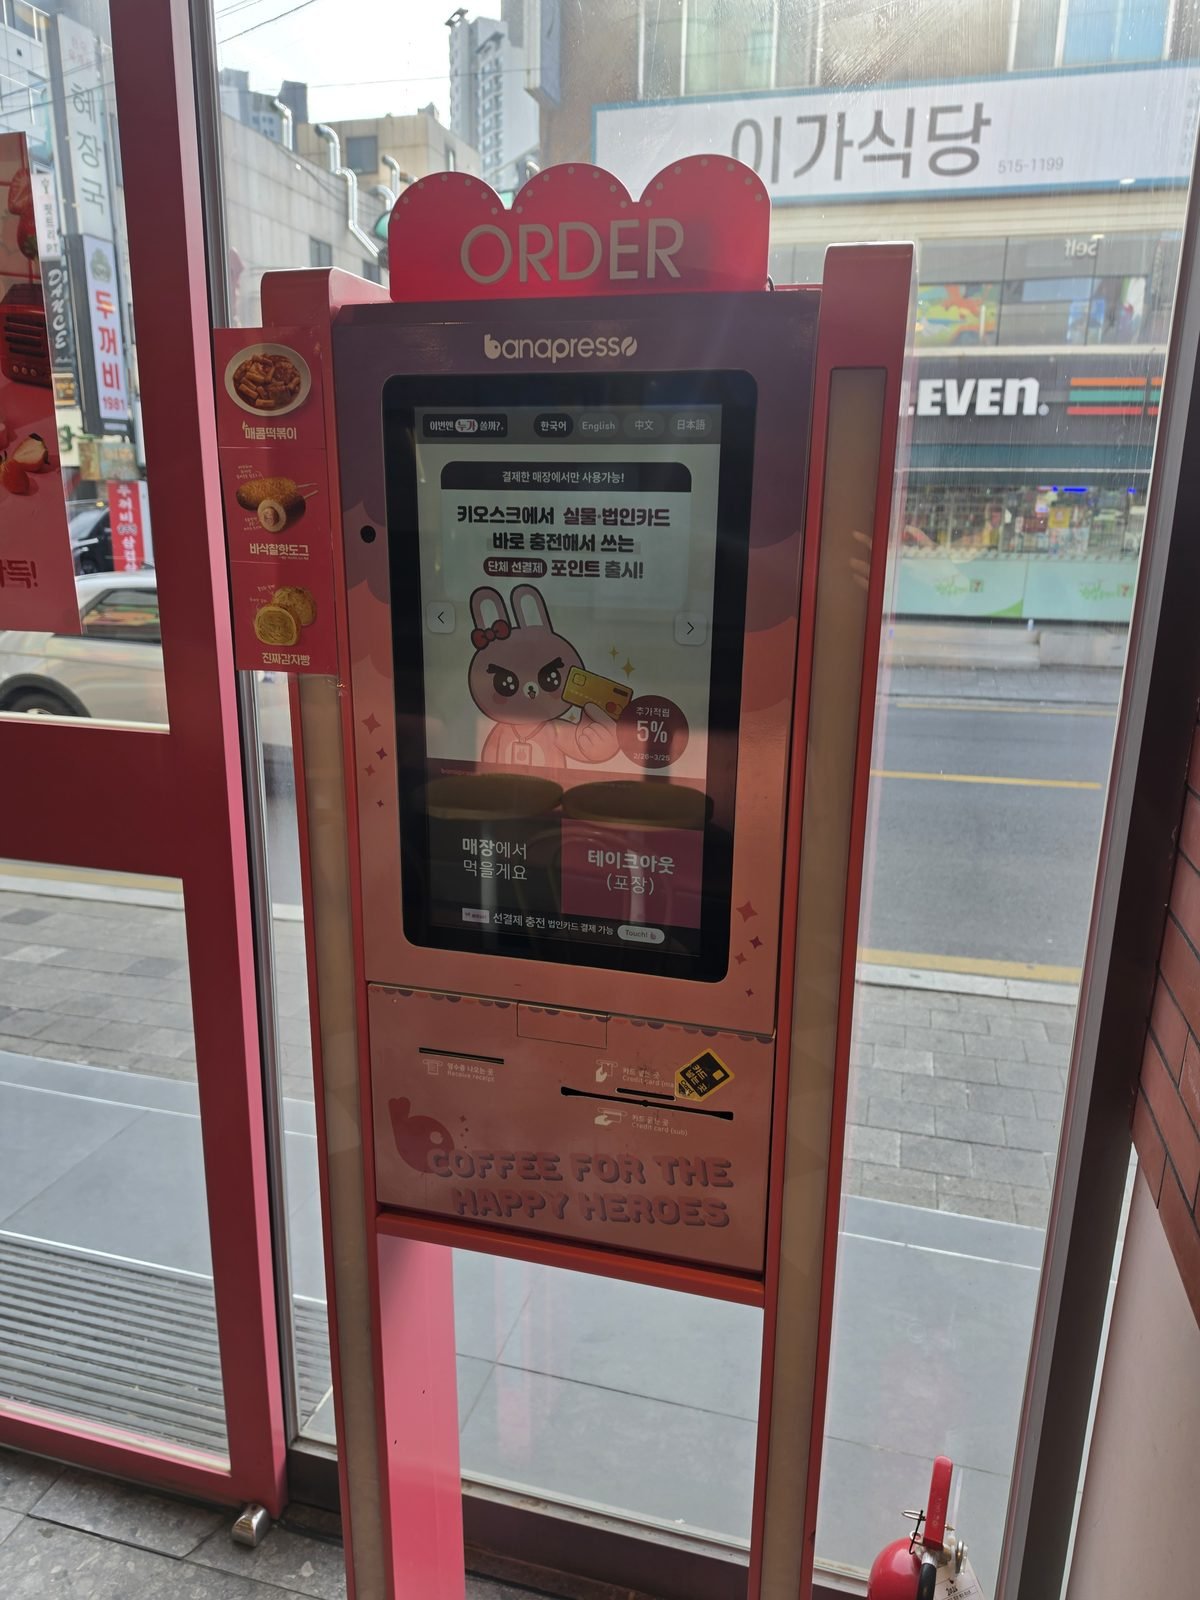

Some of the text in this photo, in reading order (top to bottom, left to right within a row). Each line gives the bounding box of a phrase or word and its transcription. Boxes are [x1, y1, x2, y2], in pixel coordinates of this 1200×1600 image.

[730, 101, 992, 184] 이가식당
[997, 156, 1064, 174] 515-1199
[460, 217, 684, 285] ORDER
[48, 268, 68, 350] DANCE
[95, 290, 120, 390] 두꺼비
[484, 333, 638, 364] banapresso
[244, 426, 298, 441] 매콤떡볶이
[540, 420, 567, 432] 한국어
[581, 420, 616, 434] English
[634, 420, 655, 432] 中文
[677, 419, 706, 432] 日本語
[502, 471, 625, 484] 결제한 매장에서만 사용가능!
[457, 505, 555, 525] 키오스크에서
[493, 532, 635, 553] 바로 충전해서 쓰는
[488, 559, 644, 580] 단체 선결제 포인트 출시!
[261, 652, 311, 666] 진짜감자빵
[636, 720, 668, 743] 5%
[462, 837, 528, 860] 매장에서
[463, 859, 528, 881] 먹을게요
[587, 849, 676, 875] 테이크아웃
[606, 874, 655, 895] (포장)
[493, 912, 523, 927] 선결제
[525, 916, 545, 929] 충전
[547, 919, 579, 932] 법인카드
[580, 922, 597, 933] 결제
[598, 925, 614, 936] 가능
[625, 929, 648, 939] Touch!
[631, 1122, 688, 1137] Credit card (sub)
[427, 1150, 735, 1188] COFFEE FOR THE
[451, 1187, 730, 1229] HAPPY HEROES
